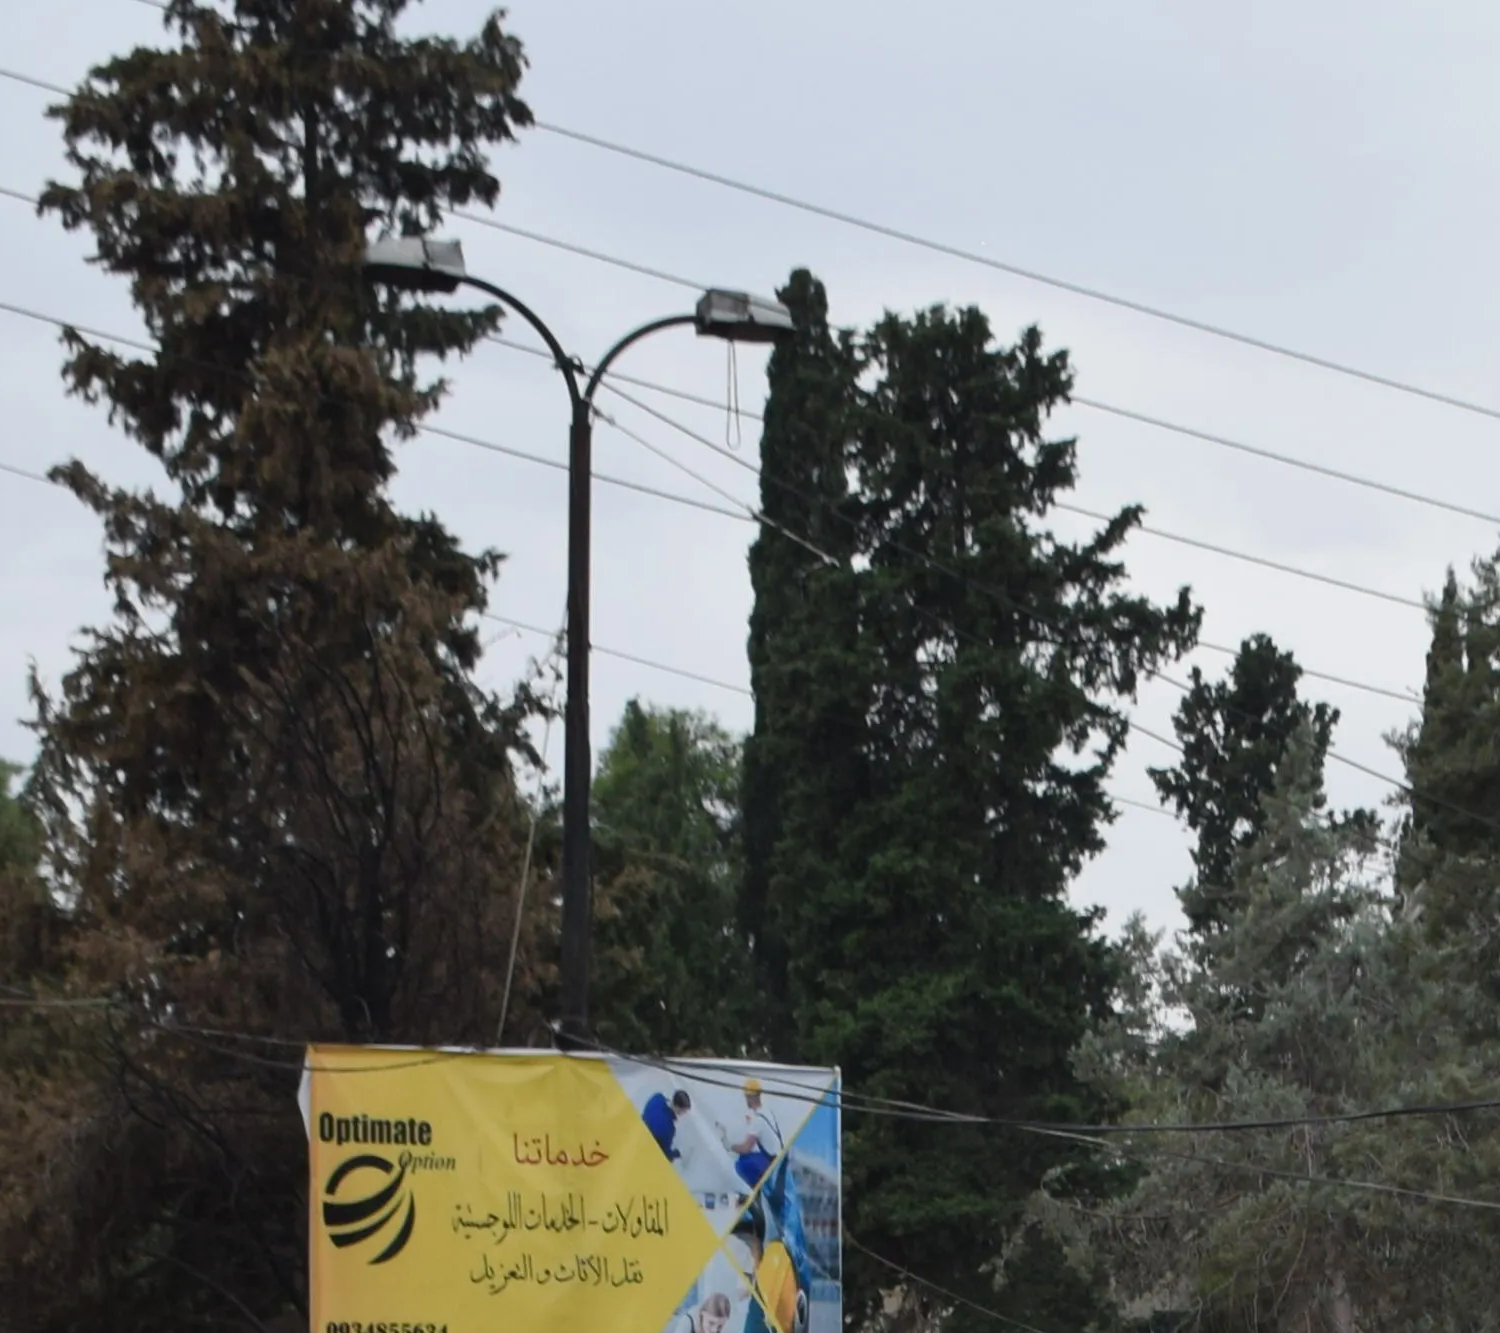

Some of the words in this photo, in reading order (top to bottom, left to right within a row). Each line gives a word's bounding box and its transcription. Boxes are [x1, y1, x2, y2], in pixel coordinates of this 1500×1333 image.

[319, 1111, 432, 1146] Optimate
[397, 1150, 456, 1175] Option
[513, 1132, 609, 1167] خدماتنا
[524, 1192, 586, 1233] الخدمات
[601, 1194, 669, 1238] المقاولات
[611, 1257, 644, 1287] نقل
